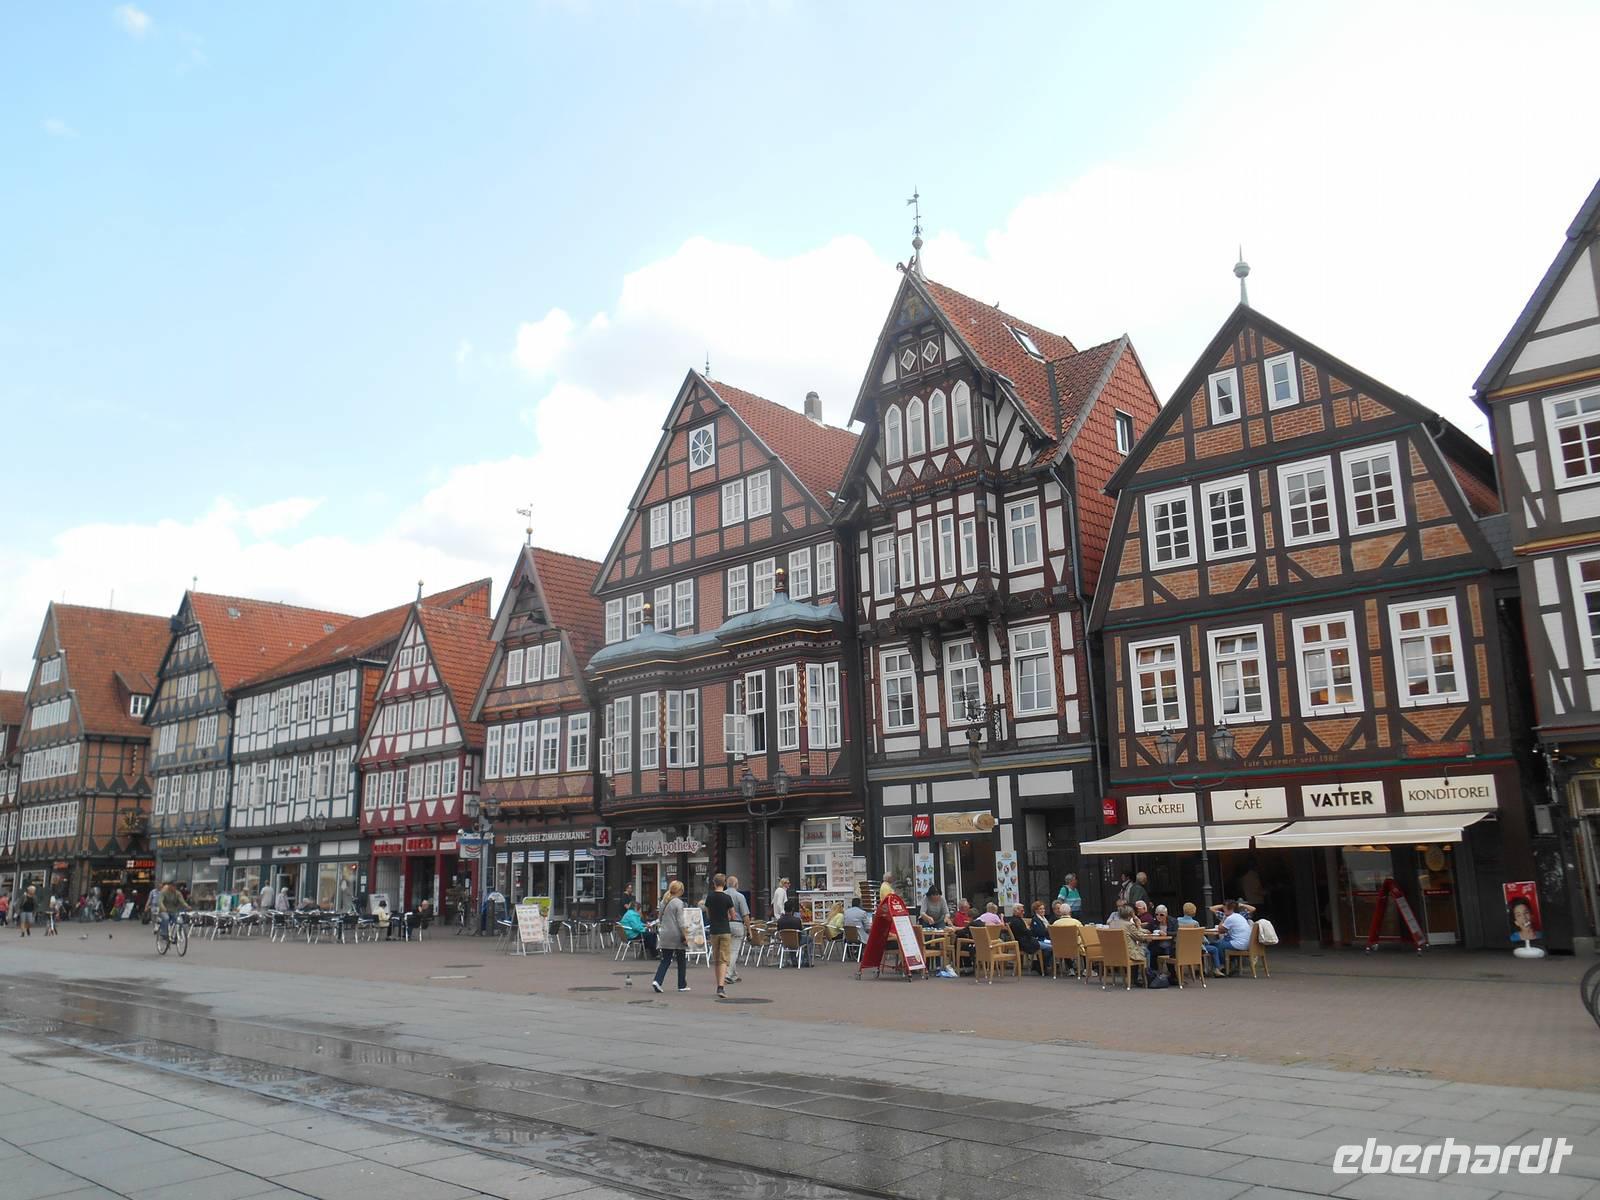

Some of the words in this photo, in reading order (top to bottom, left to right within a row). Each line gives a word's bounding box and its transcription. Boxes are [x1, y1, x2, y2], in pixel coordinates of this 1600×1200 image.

[1310, 790, 1374, 807] VATTER
[1408, 786, 1490, 801] KONDITOREI
[1138, 803, 1186, 816] BÄCKEREI
[1234, 796, 1262, 810] CAFÉ
[914, 819, 929, 836] illy
